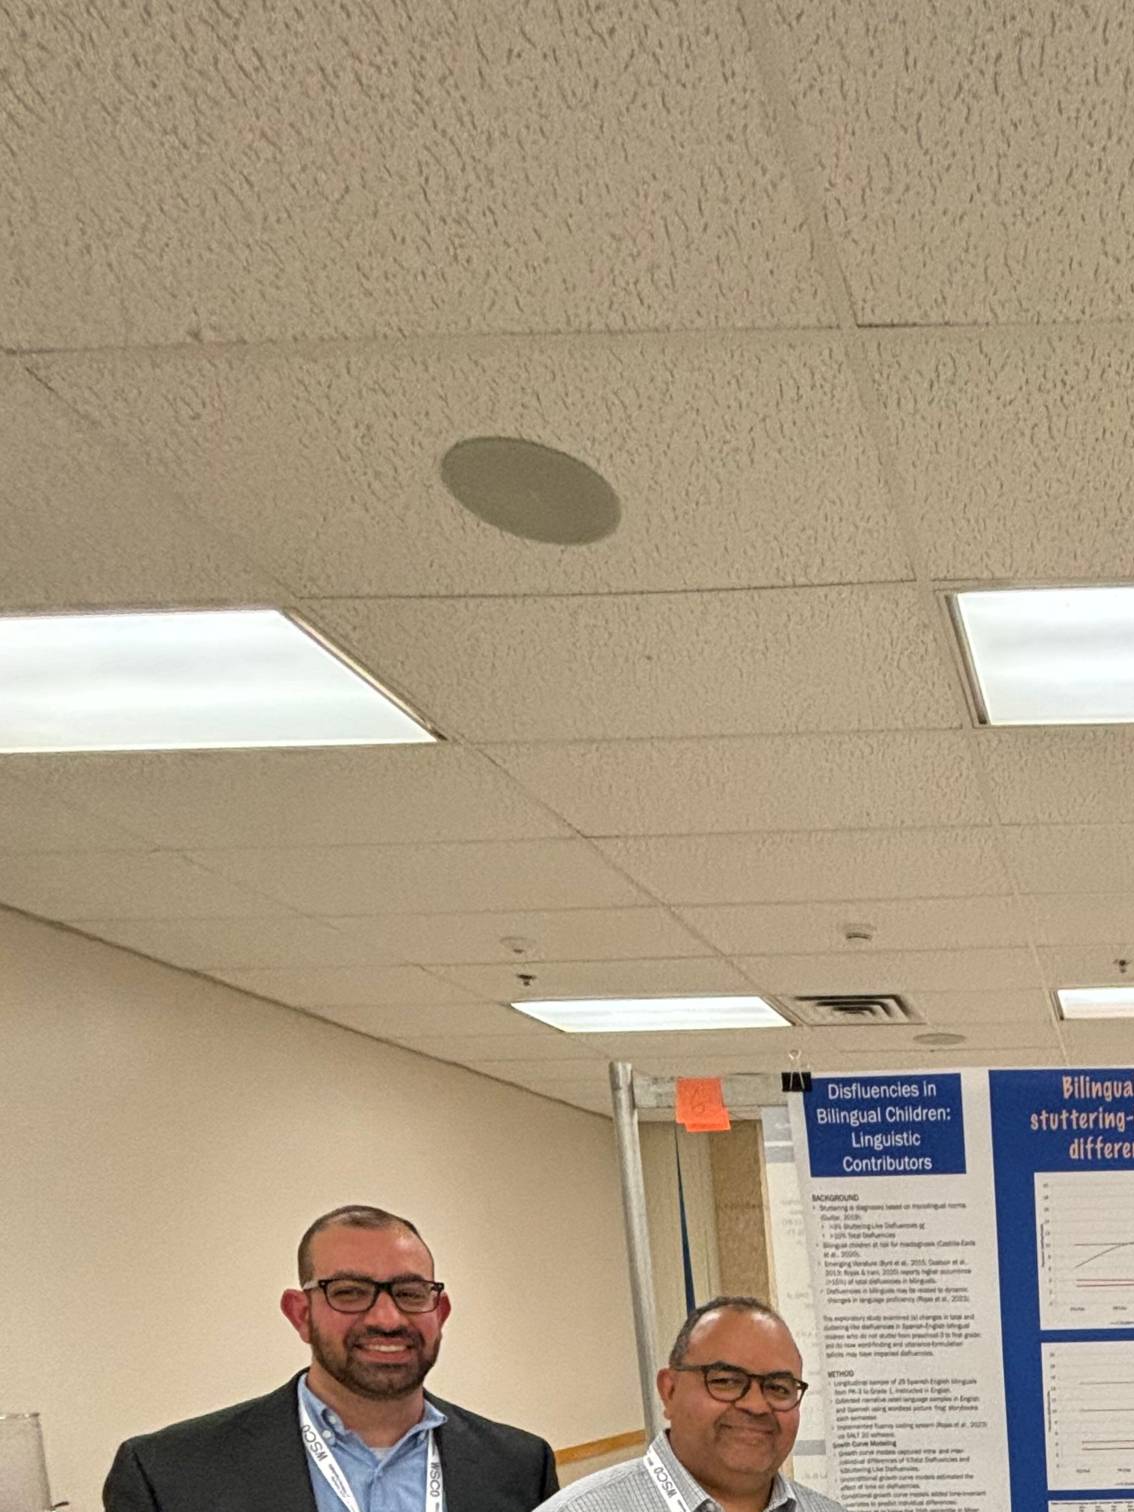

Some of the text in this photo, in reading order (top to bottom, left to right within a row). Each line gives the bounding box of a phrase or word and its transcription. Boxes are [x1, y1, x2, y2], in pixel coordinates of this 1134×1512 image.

[827, 1081, 937, 1100] Disfluencies in
[816, 1106, 951, 1126] Bilingual Children:
[851, 1131, 921, 1150] Linguistic
[843, 1155, 933, 1172] Contributors
[812, 1194, 859, 1202] BACKGROUND
[827, 1370, 855, 1378] METHOD
